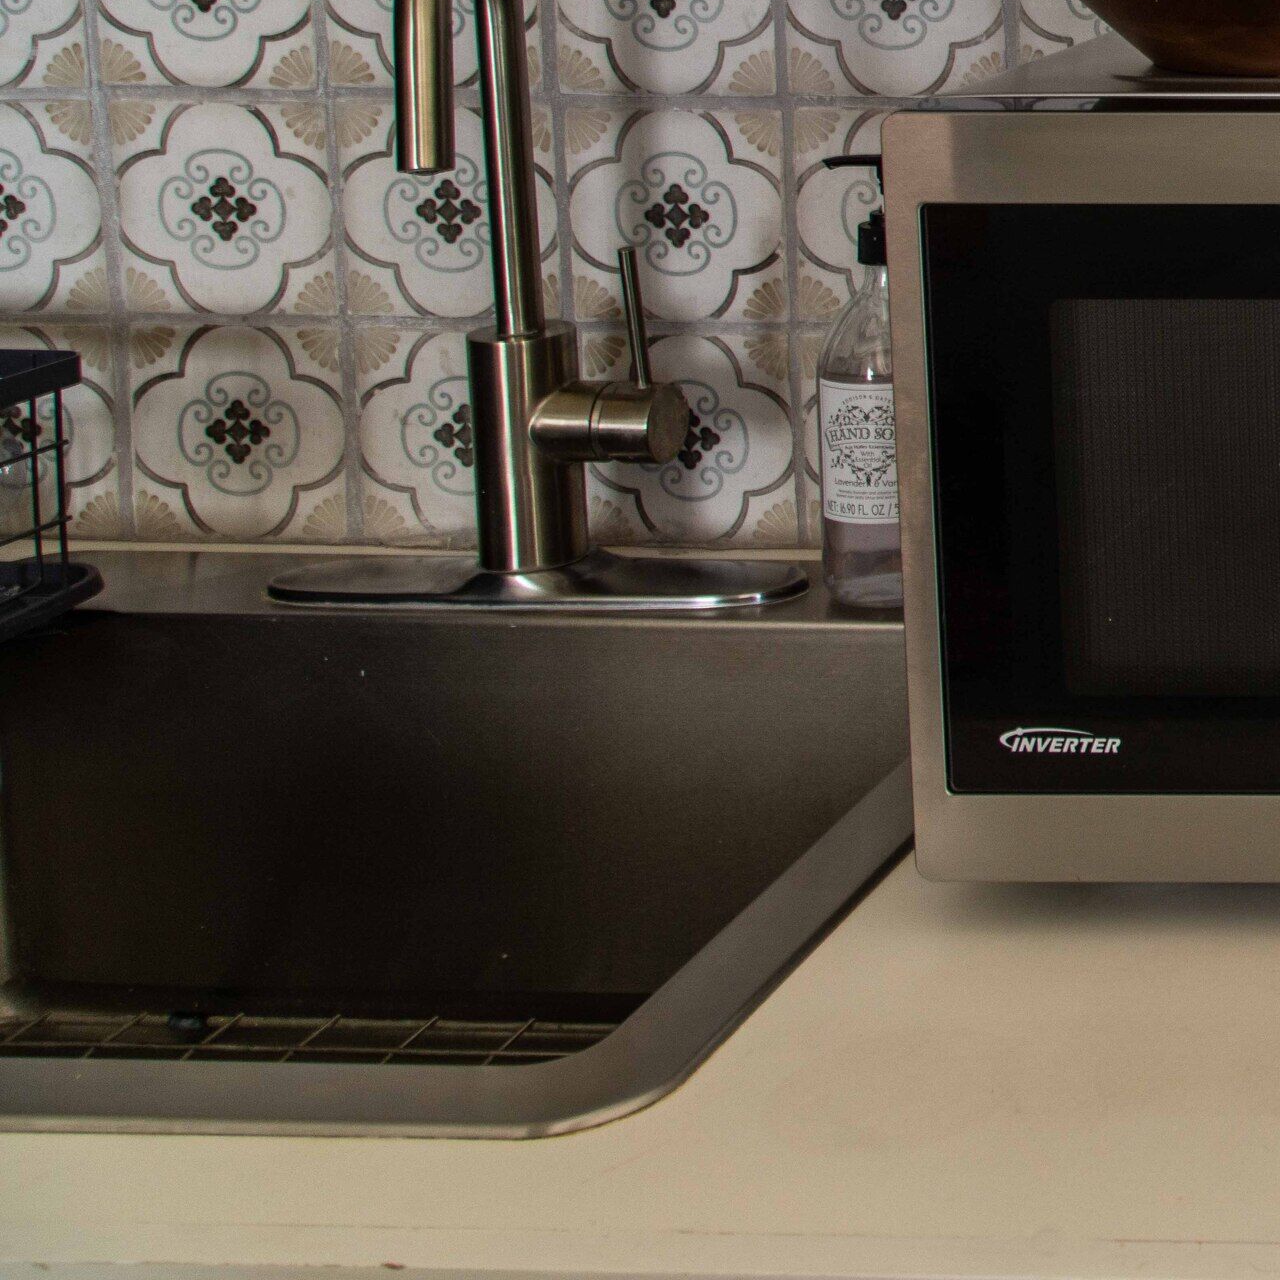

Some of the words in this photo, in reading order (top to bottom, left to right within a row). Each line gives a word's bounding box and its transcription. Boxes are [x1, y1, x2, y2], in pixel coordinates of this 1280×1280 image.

[829, 427, 871, 443] HAND
[874, 427, 896, 441] SO
[834, 477, 865, 487] Lavender
[871, 504, 885, 516] OZ
[1011, 737, 1121, 753] INVERTER
